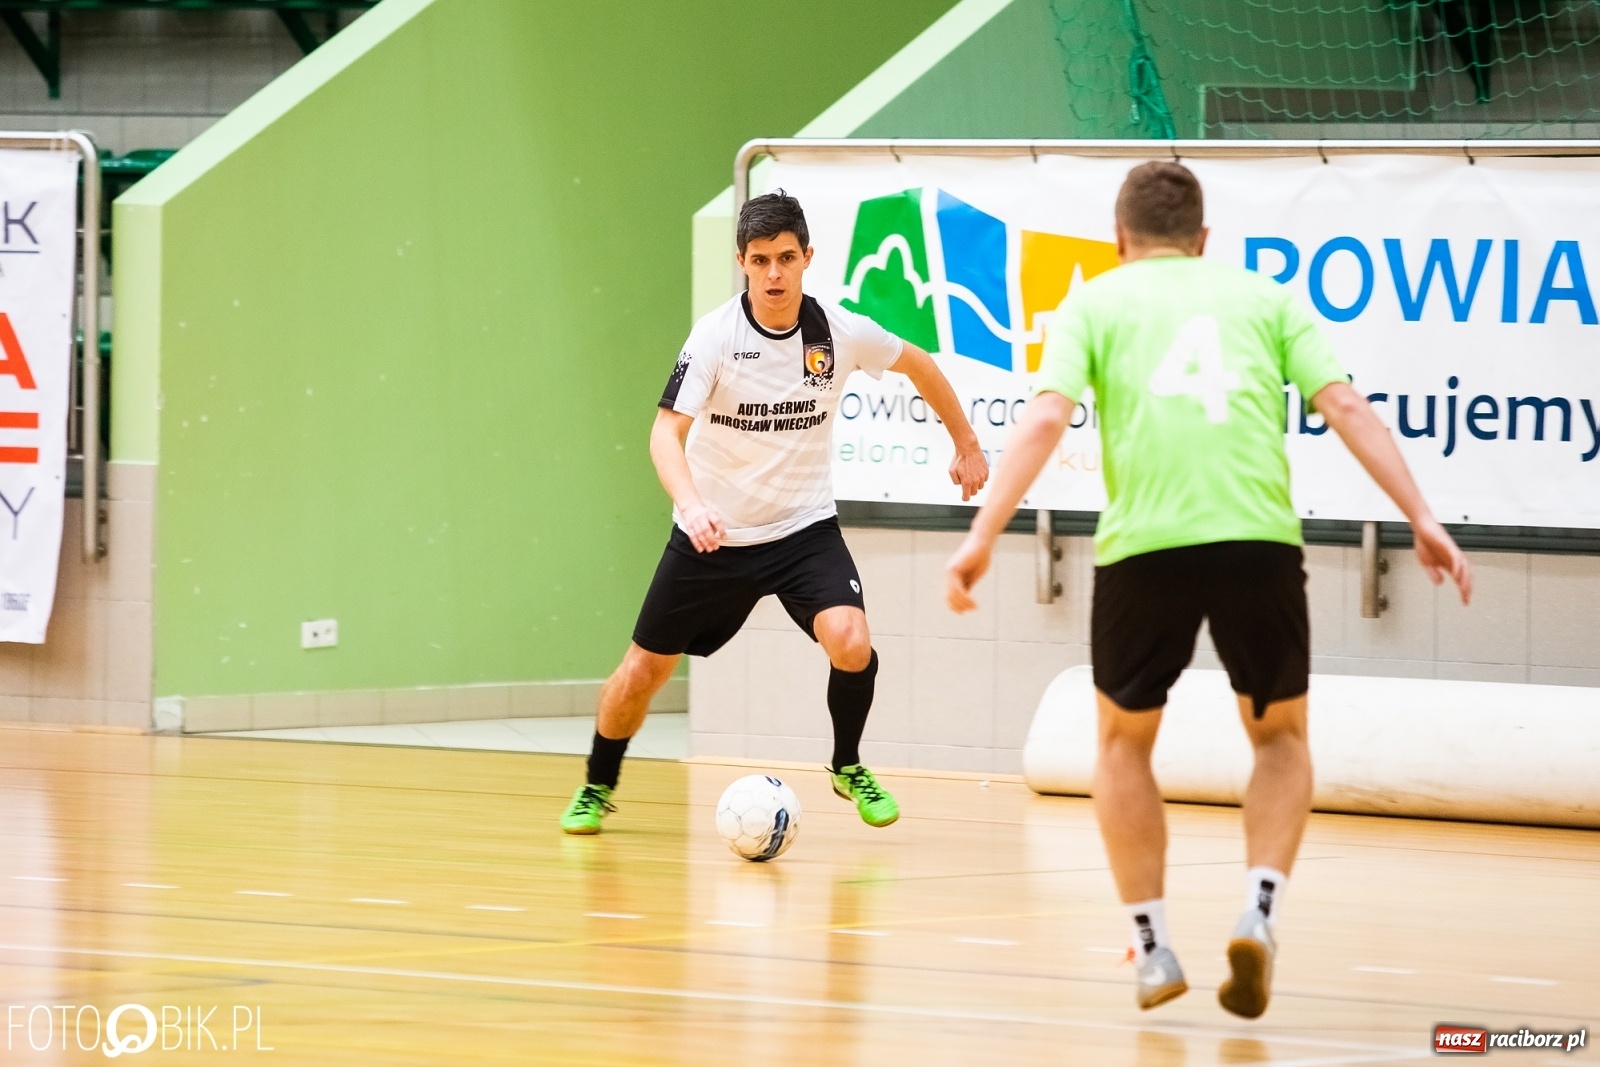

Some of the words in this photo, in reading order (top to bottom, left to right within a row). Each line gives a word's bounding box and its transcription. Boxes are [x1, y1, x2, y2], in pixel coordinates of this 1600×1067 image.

[1148, 314, 1241, 425] 4
[737, 399, 816, 417] AUTO-SERWIS
[840, 382, 943, 424] owia
[710, 413, 772, 432] MIROSŁAW
